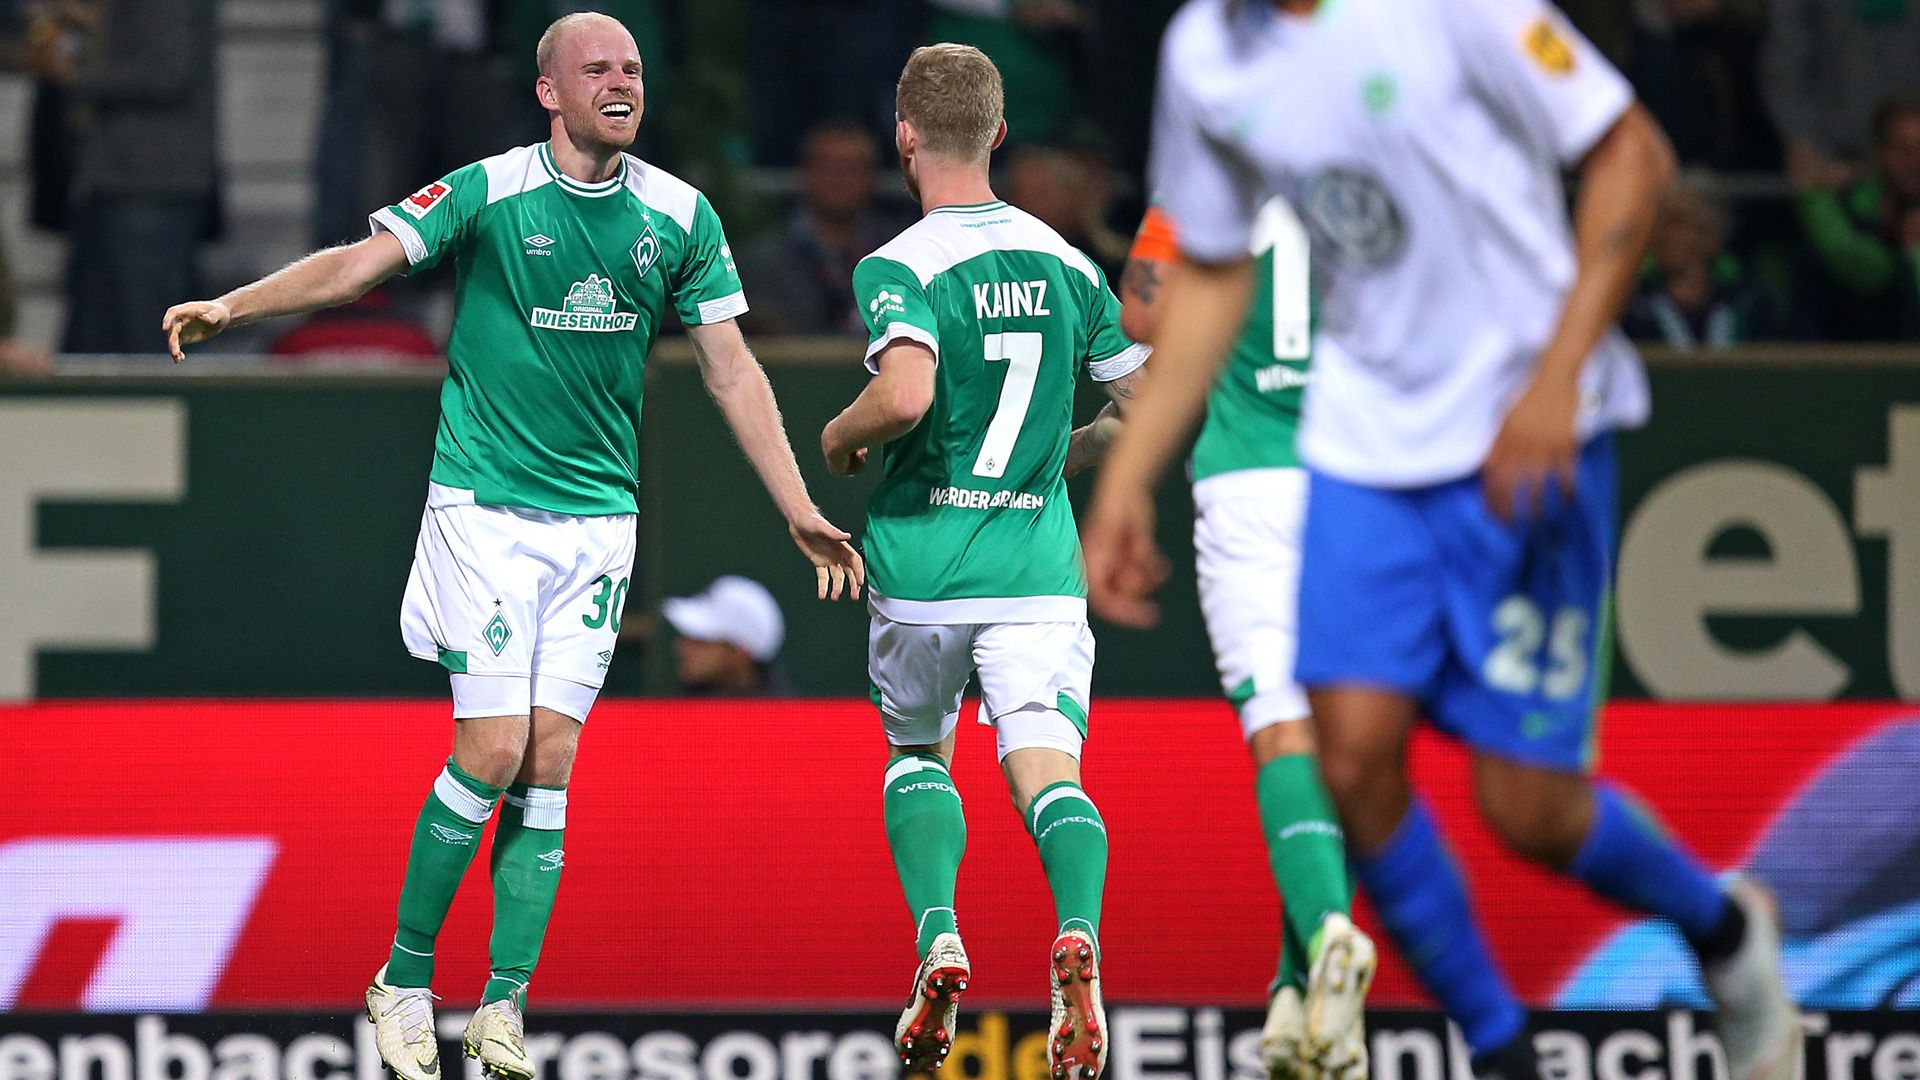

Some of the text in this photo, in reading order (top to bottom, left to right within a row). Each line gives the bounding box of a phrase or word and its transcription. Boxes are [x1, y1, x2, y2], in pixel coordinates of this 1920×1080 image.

[525, 248, 552, 256] umbro
[572, 305, 604, 313] ORIGINAL
[972, 279, 1051, 320] KAINZ
[534, 310, 635, 330] WIESENHOF
[970, 331, 1043, 479] 7
[989, 489, 1044, 510] BRMEN
[582, 574, 629, 634] 30
[1483, 595, 1590, 702] 25
[896, 781, 962, 804] WERDE
